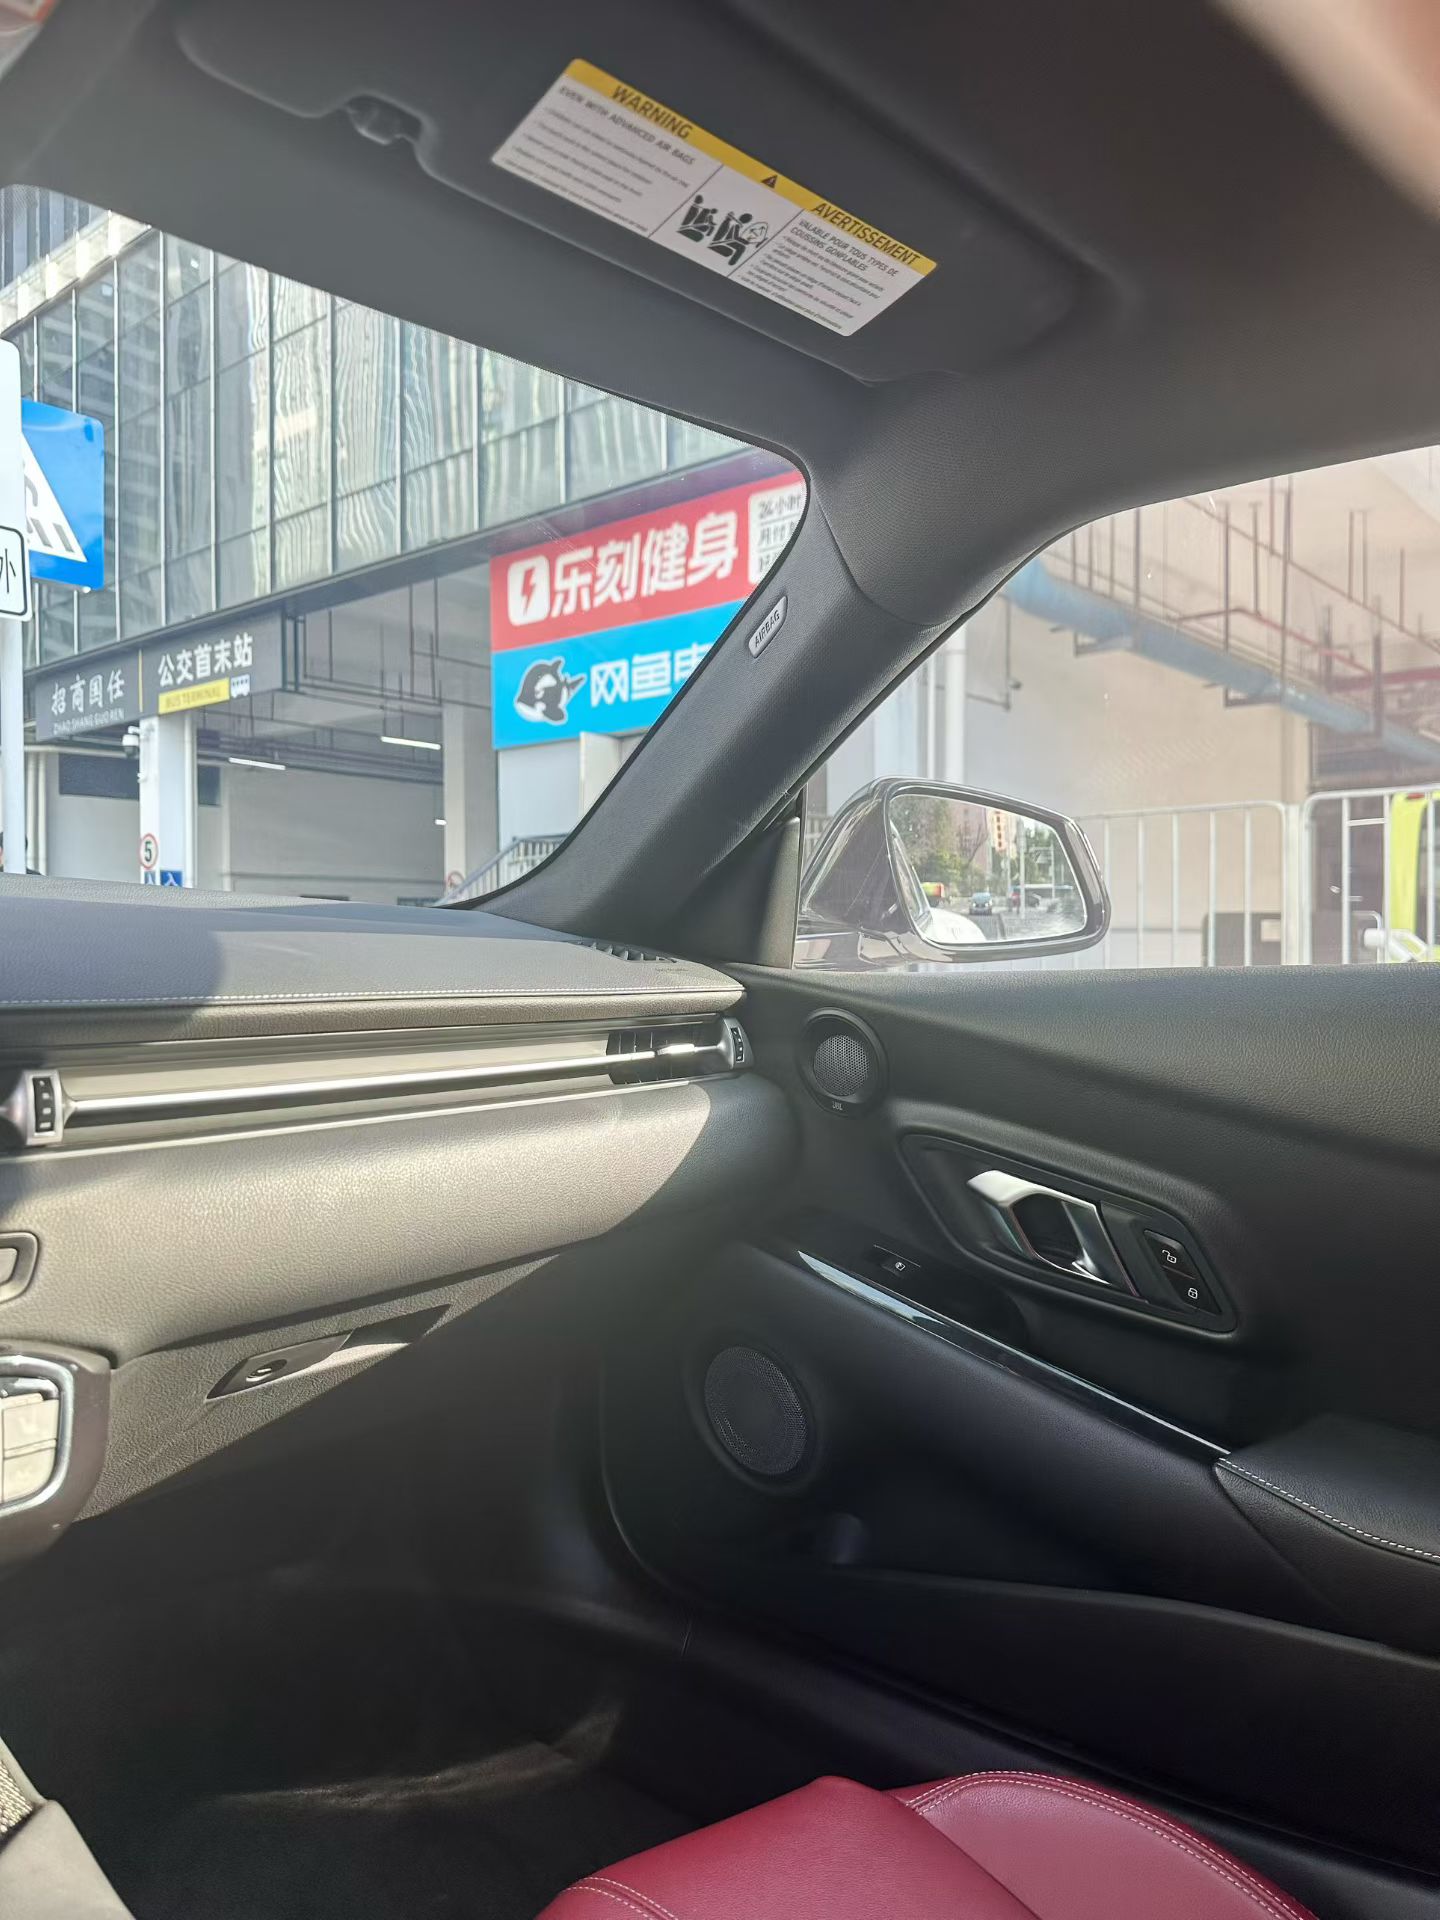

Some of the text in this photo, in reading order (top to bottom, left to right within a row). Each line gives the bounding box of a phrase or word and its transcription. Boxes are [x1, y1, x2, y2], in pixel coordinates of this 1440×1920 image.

[559, 86, 696, 166] EVEN WITH ADVANCED AIR BAGS
[611, 85, 694, 140] WARNING
[790, 226, 825, 249] COUSSINS
[825, 245, 869, 272] GONFLABLES
[798, 219, 899, 277] VALABLE POUR TOUS TYPES DE
[811, 202, 921, 266] AVERTISSEMENT
[551, 511, 738, 618] 乐刻健身
[755, 610, 780, 648] AIRBAG
[157, 632, 253, 687] 公交首末站
[51, 669, 125, 716] 招商国任
[144, 840, 152, 862] 5
[832, 1100, 843, 1111] JBL
